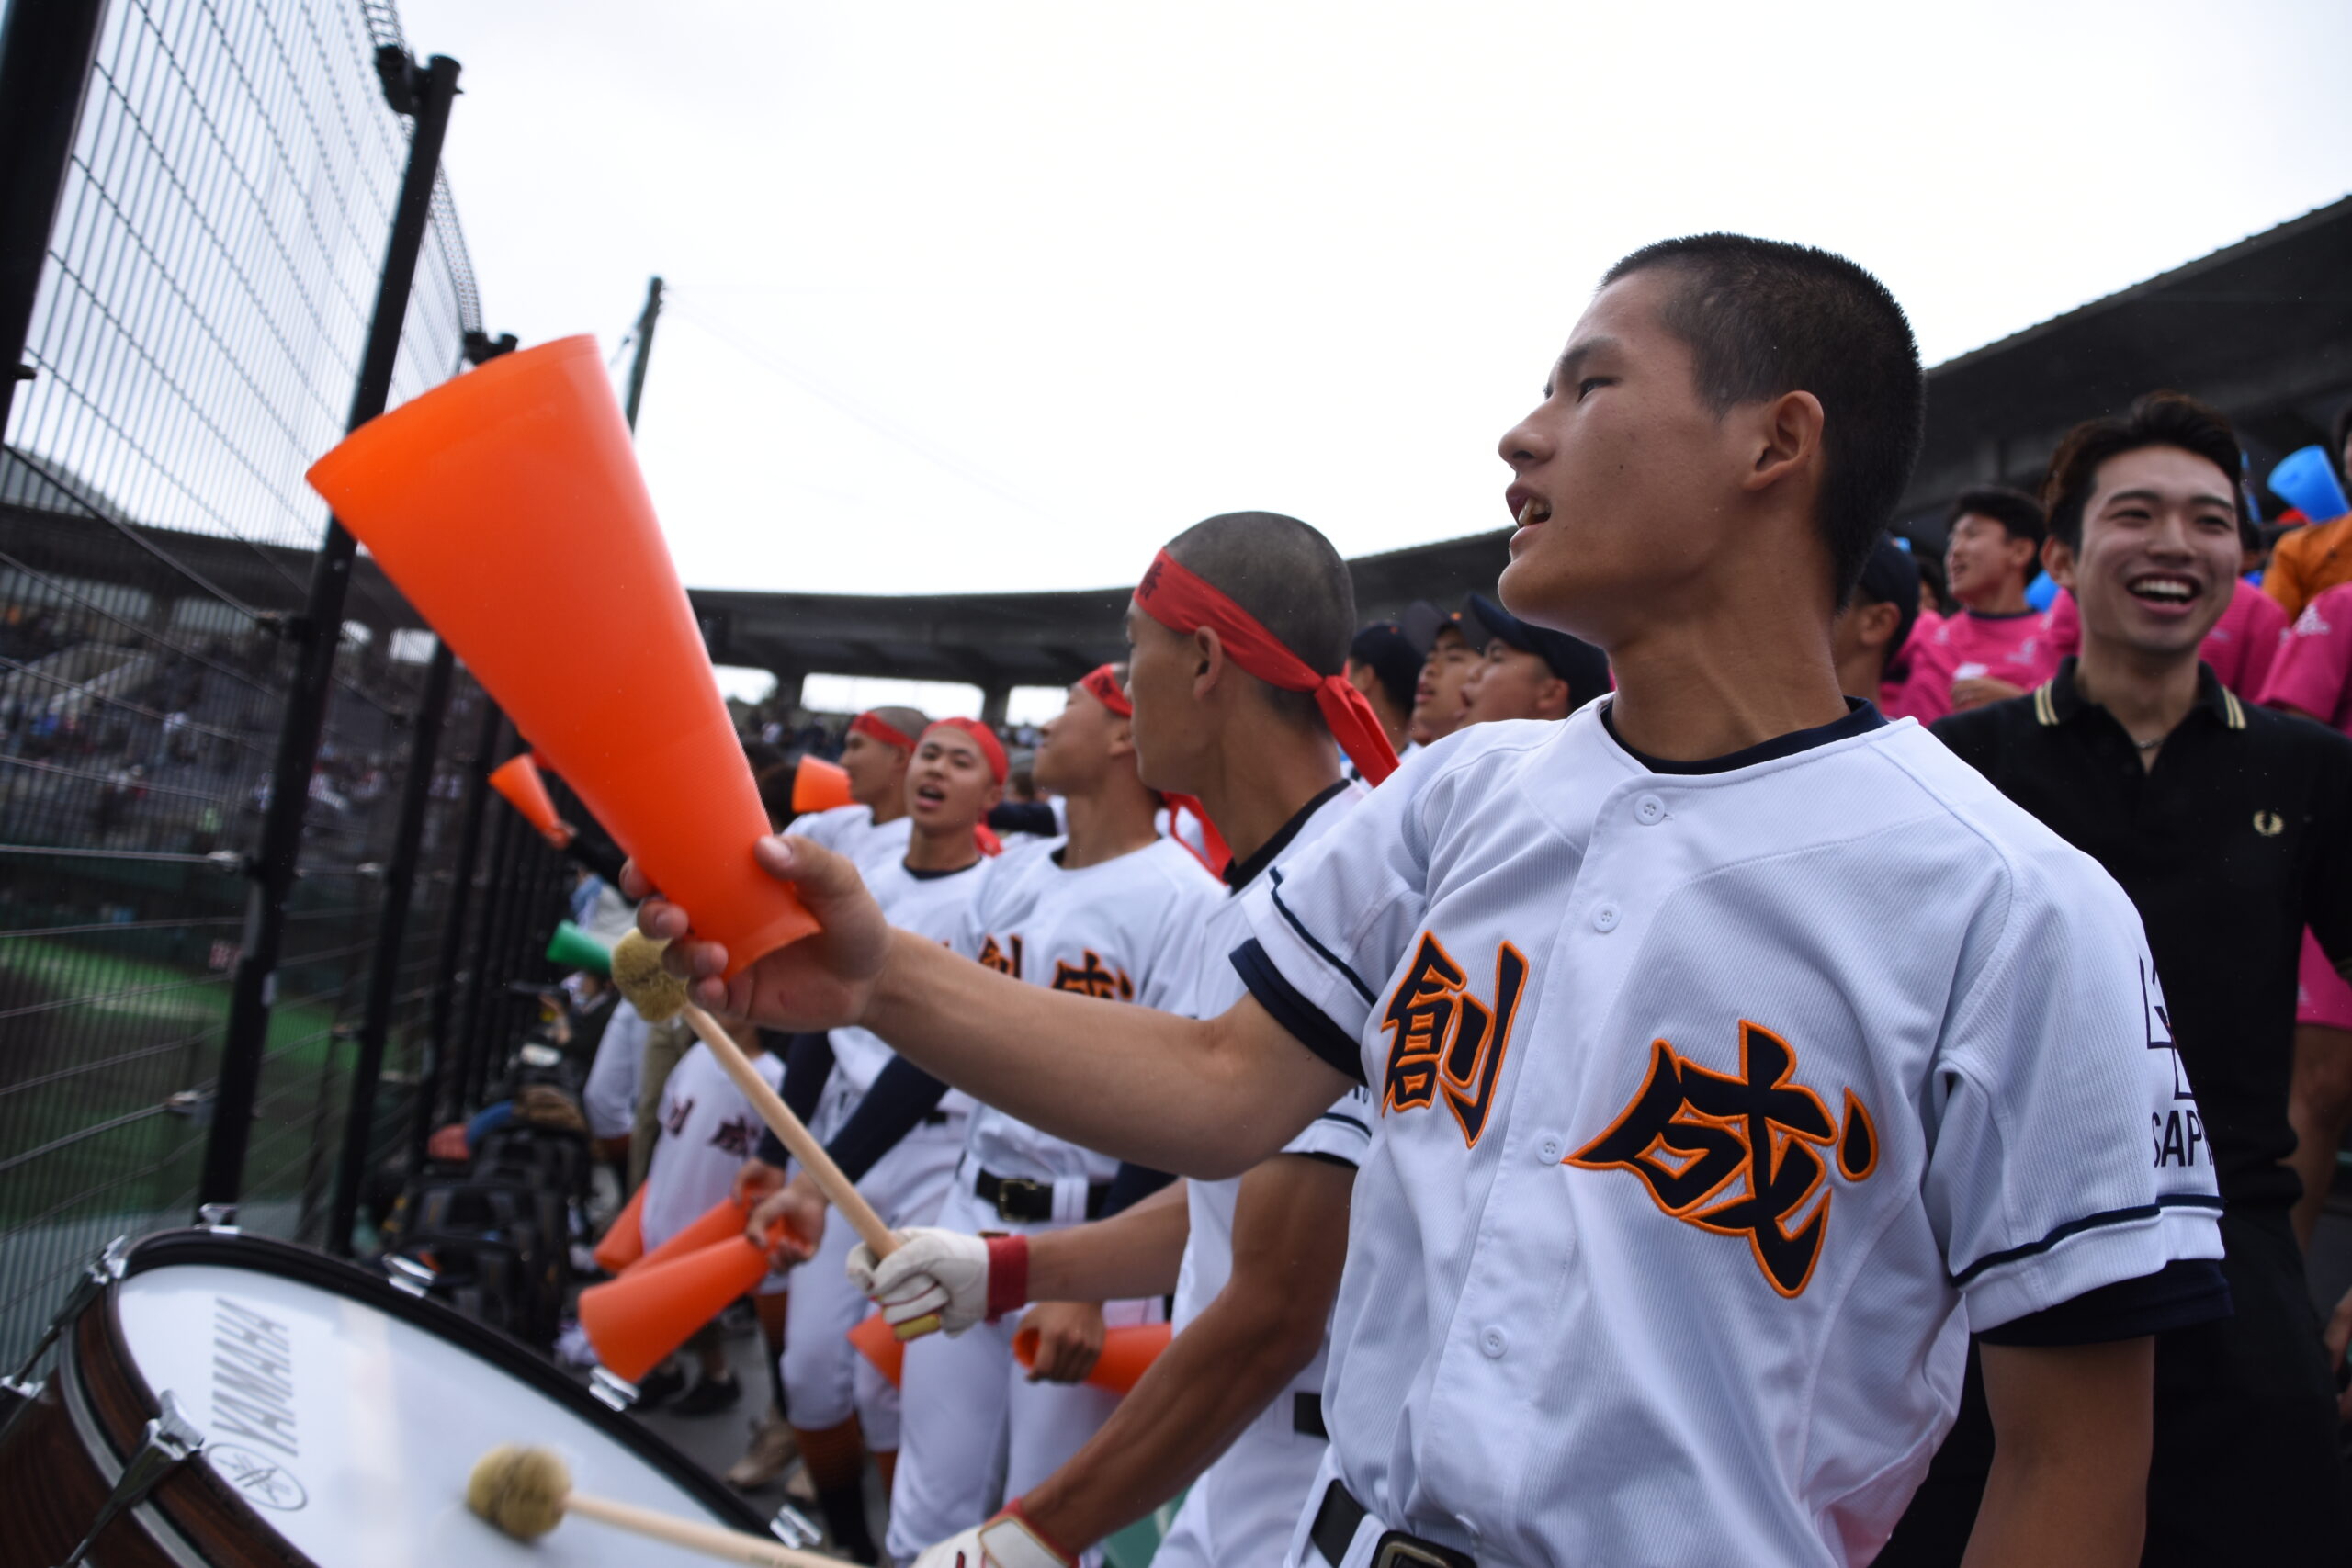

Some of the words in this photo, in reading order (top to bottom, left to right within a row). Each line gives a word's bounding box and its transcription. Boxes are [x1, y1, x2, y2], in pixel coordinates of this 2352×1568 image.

[1381, 930, 1880, 1300] 創成
[2151, 1110, 2214, 1168] SAP
[211, 1297, 299, 1458] YAMAHA
